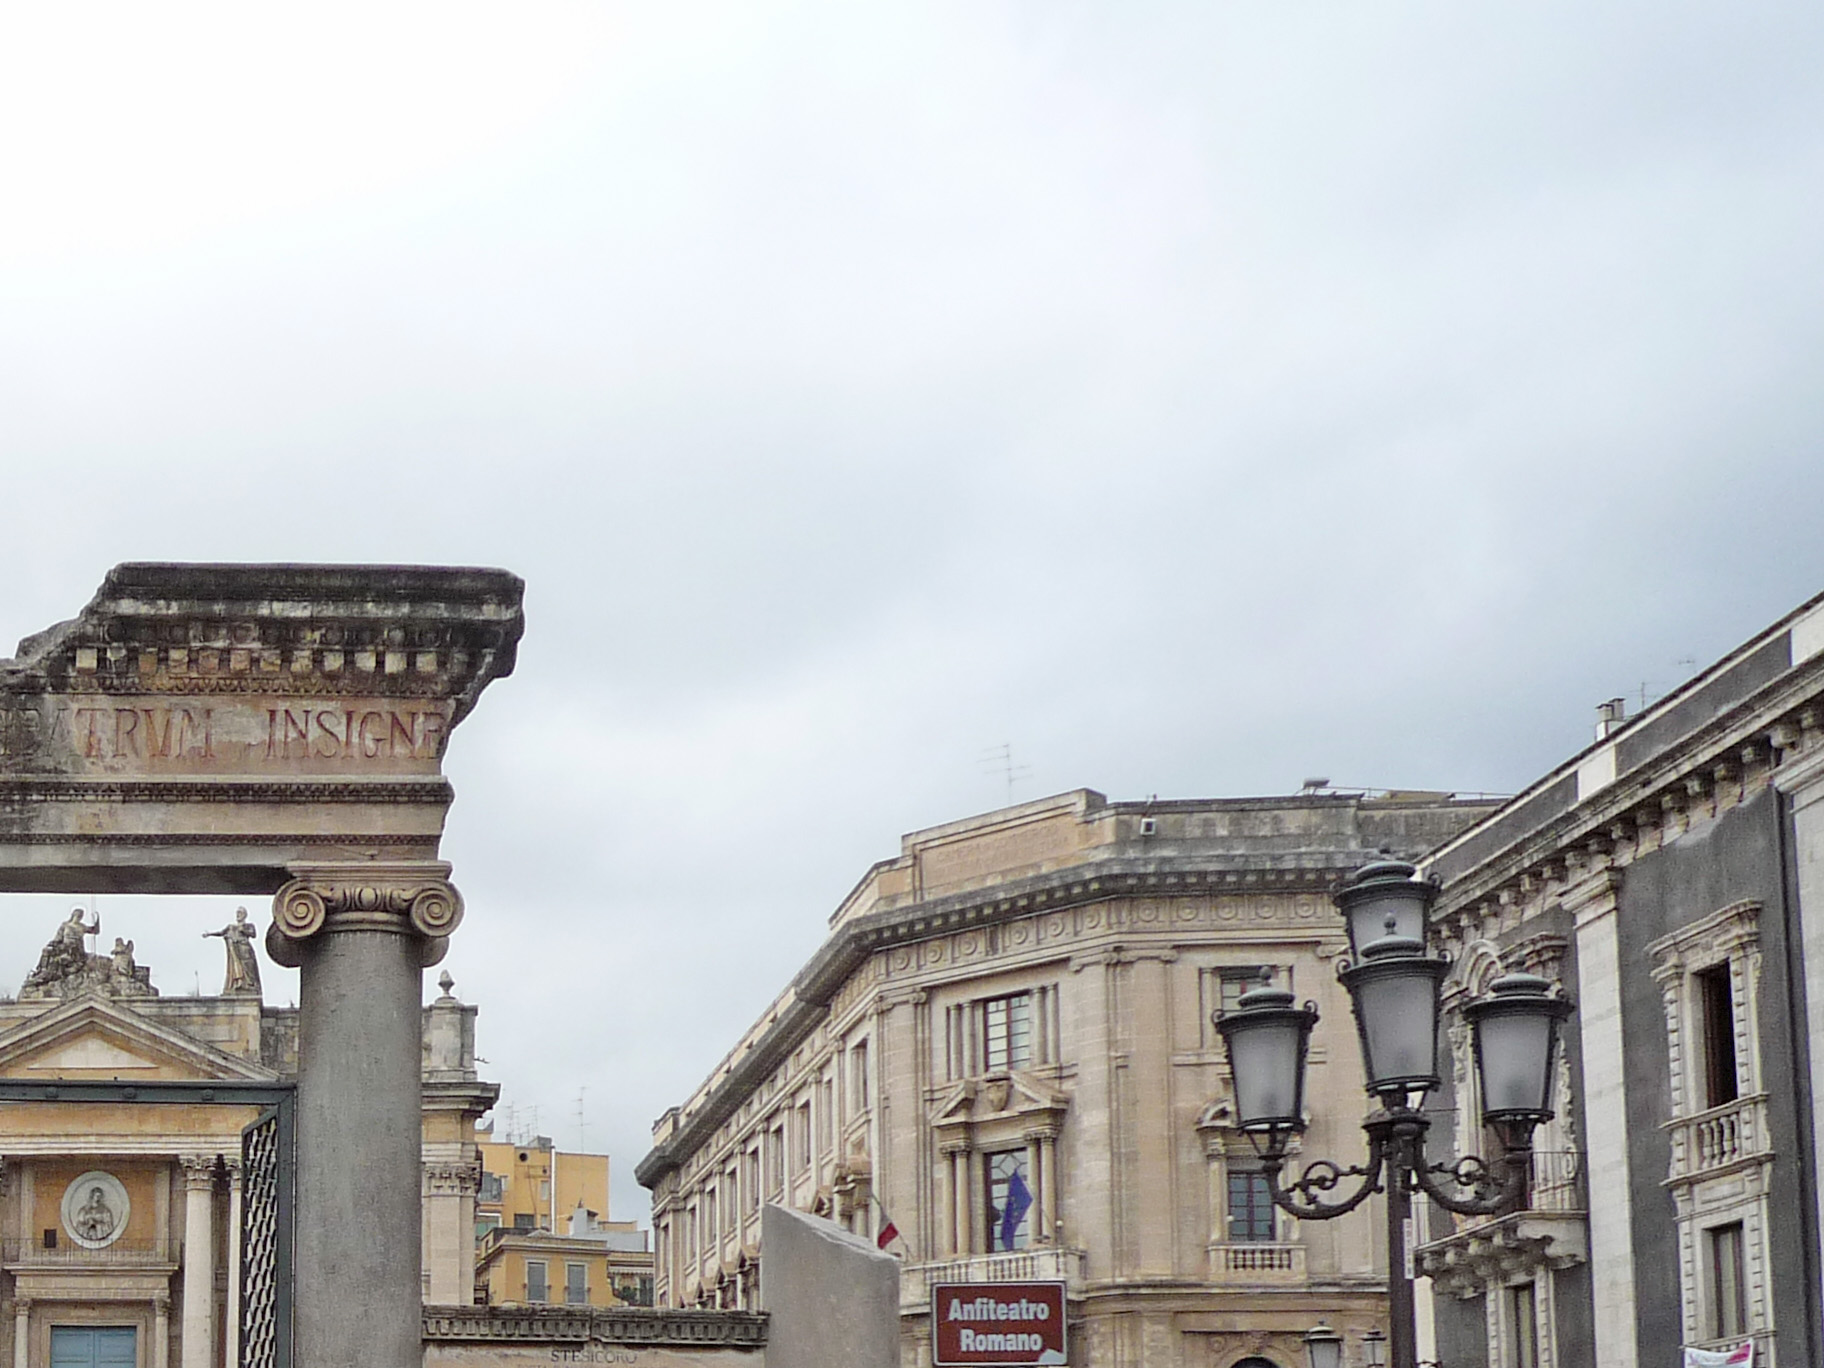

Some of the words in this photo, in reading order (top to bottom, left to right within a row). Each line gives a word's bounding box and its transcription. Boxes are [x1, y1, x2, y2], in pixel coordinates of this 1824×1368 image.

[265, 707, 446, 760] INSIGNE
[948, 1296, 1050, 1321] Anfiteatro
[960, 1328, 1043, 1353] Romano
[550, 1349, 638, 1364] STESICORO
